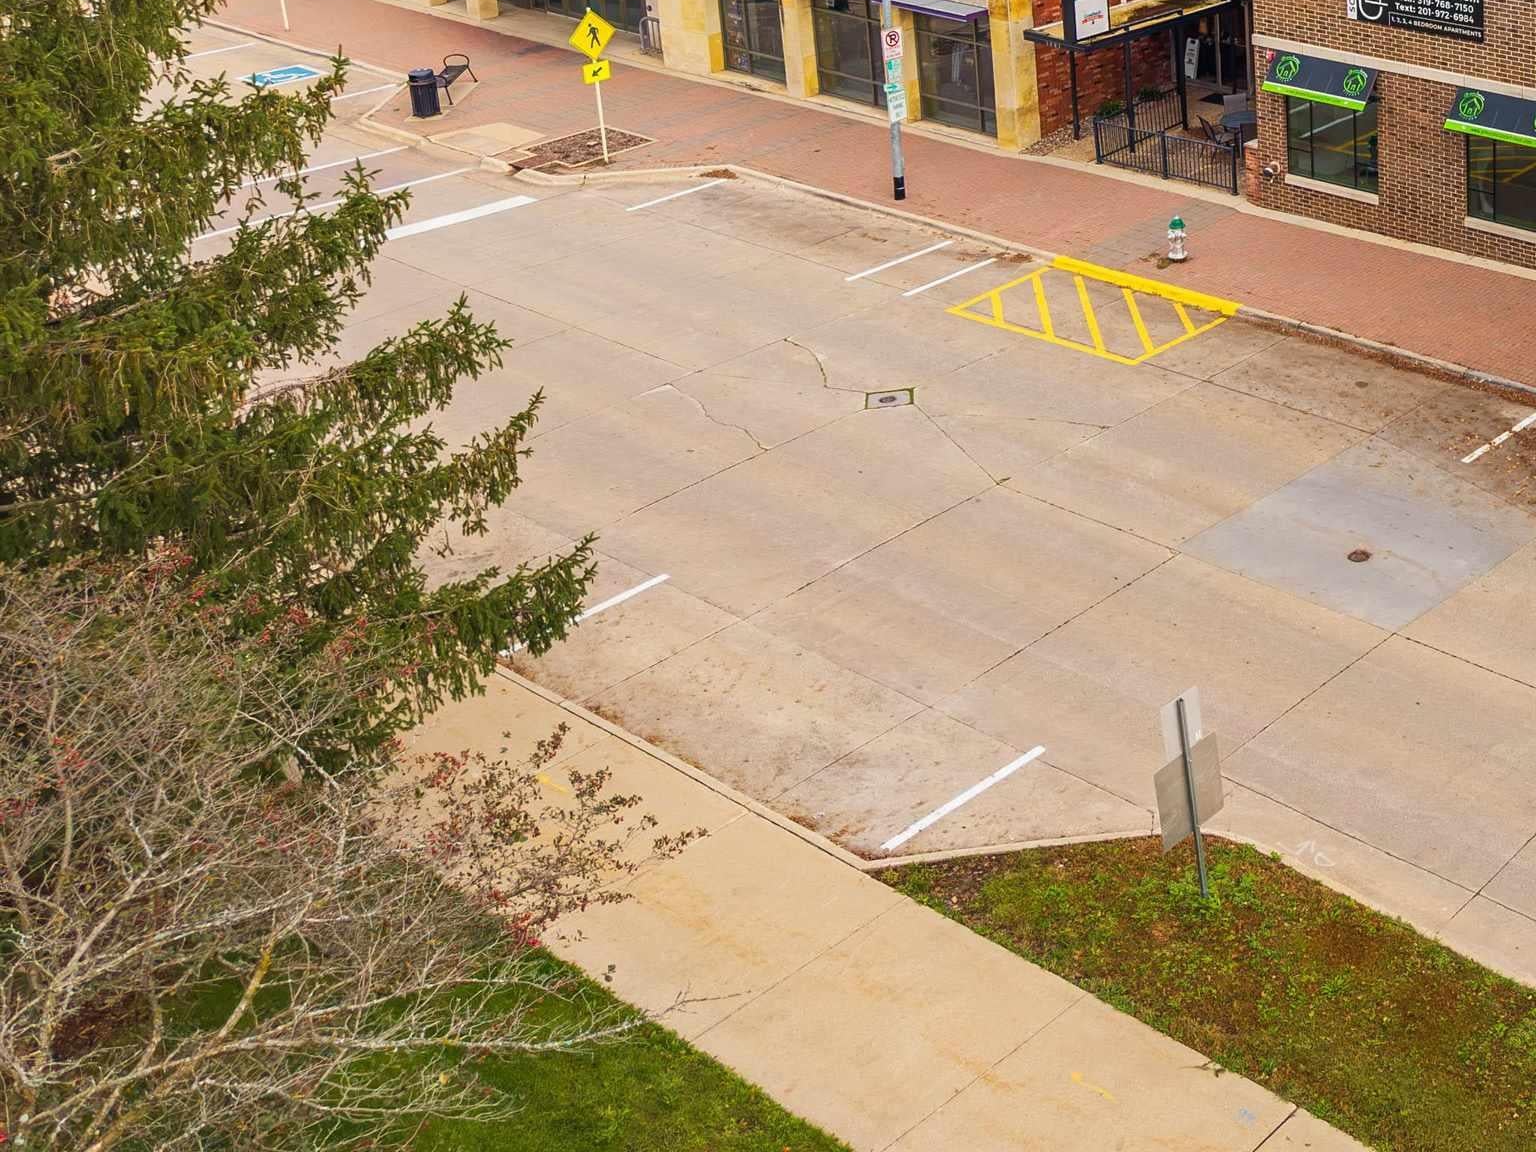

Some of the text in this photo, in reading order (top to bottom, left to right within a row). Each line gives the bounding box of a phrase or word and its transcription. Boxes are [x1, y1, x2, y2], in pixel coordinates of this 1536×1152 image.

[1395, 2, 1474, 24] Text: 201-972-6984
[1413, 20, 1443, 30] BEDROOM
[1443, 26, 1482, 38] APARTMENTS
